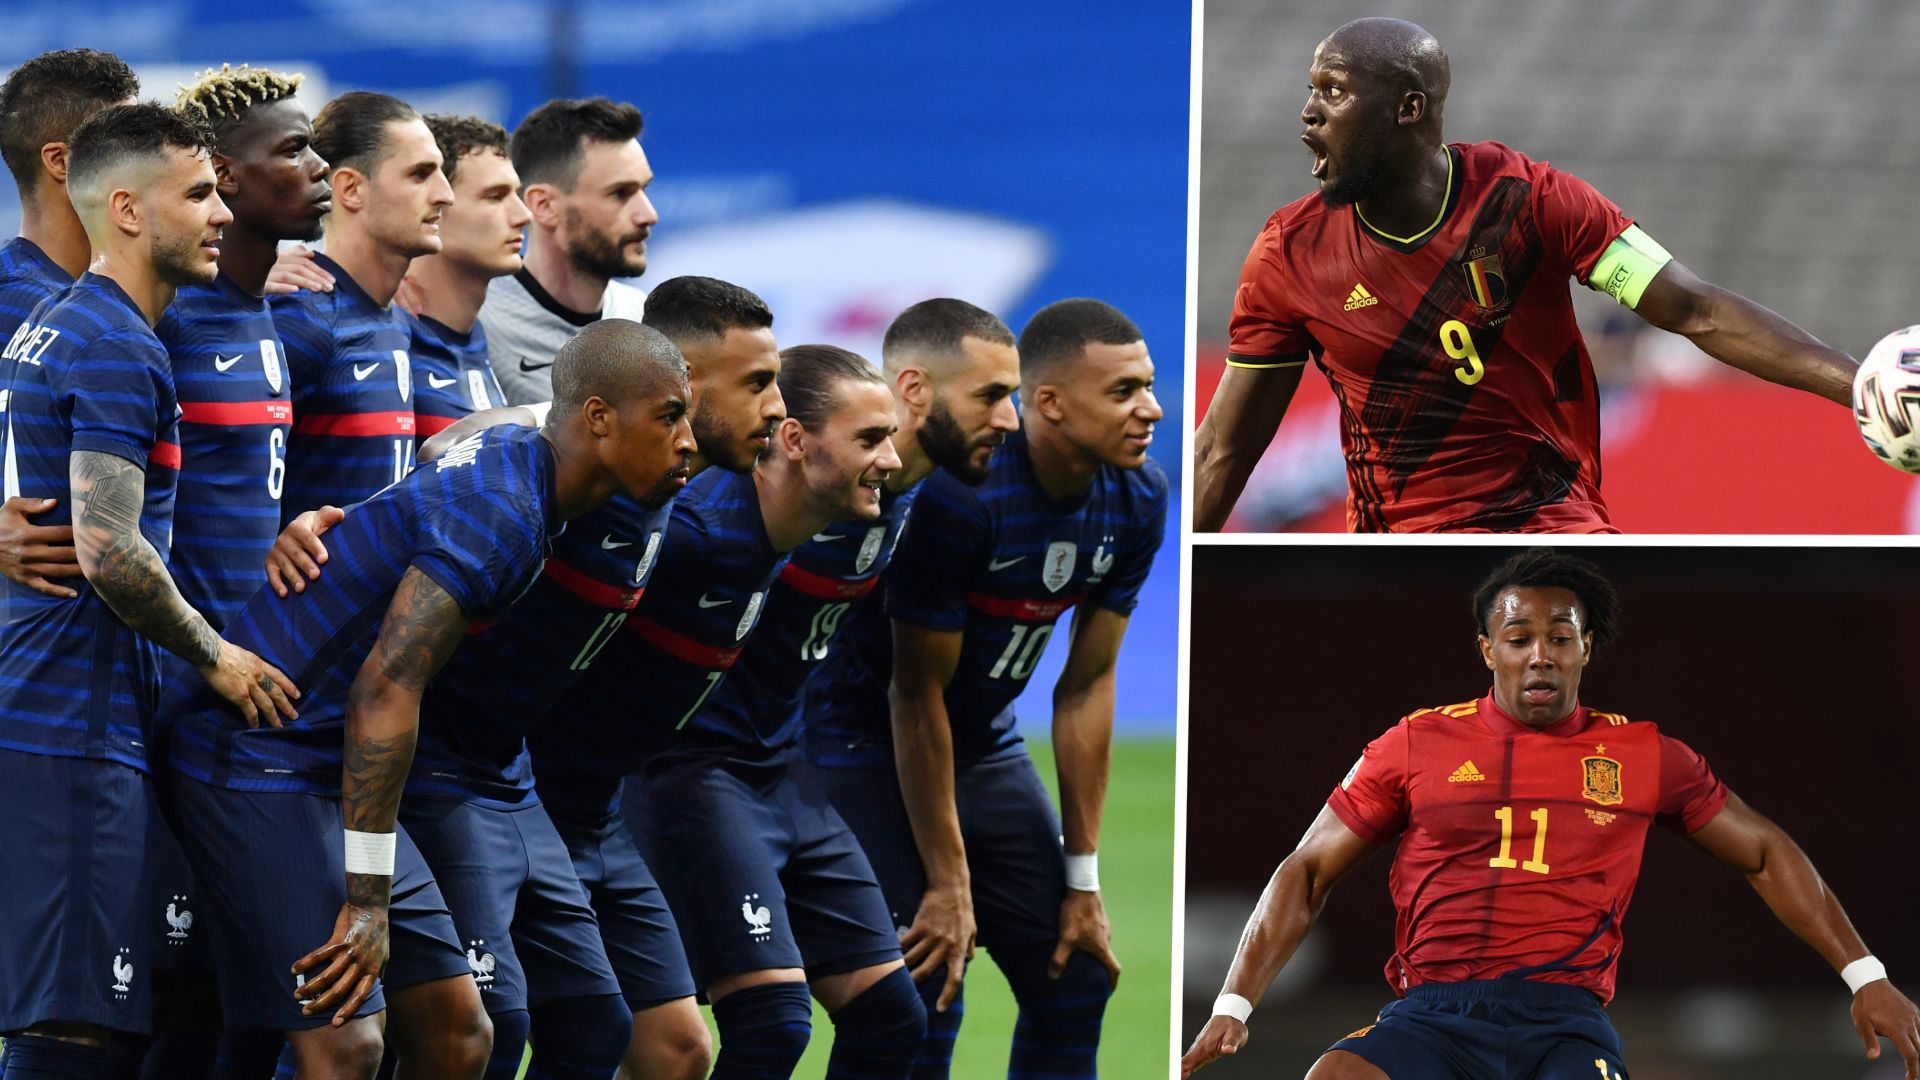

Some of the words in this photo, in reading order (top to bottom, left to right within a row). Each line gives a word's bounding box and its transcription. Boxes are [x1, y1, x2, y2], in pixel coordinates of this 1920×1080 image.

[1343, 296, 1379, 312] adidas
[1439, 319, 1485, 386] 9
[267, 428, 286, 500] 6
[569, 612, 628, 671] 12
[801, 602, 851, 661] 19
[988, 624, 1055, 680] 10
[675, 671, 723, 731] 7
[1447, 773, 1486, 783] adidas
[1489, 806, 1550, 875] 11
